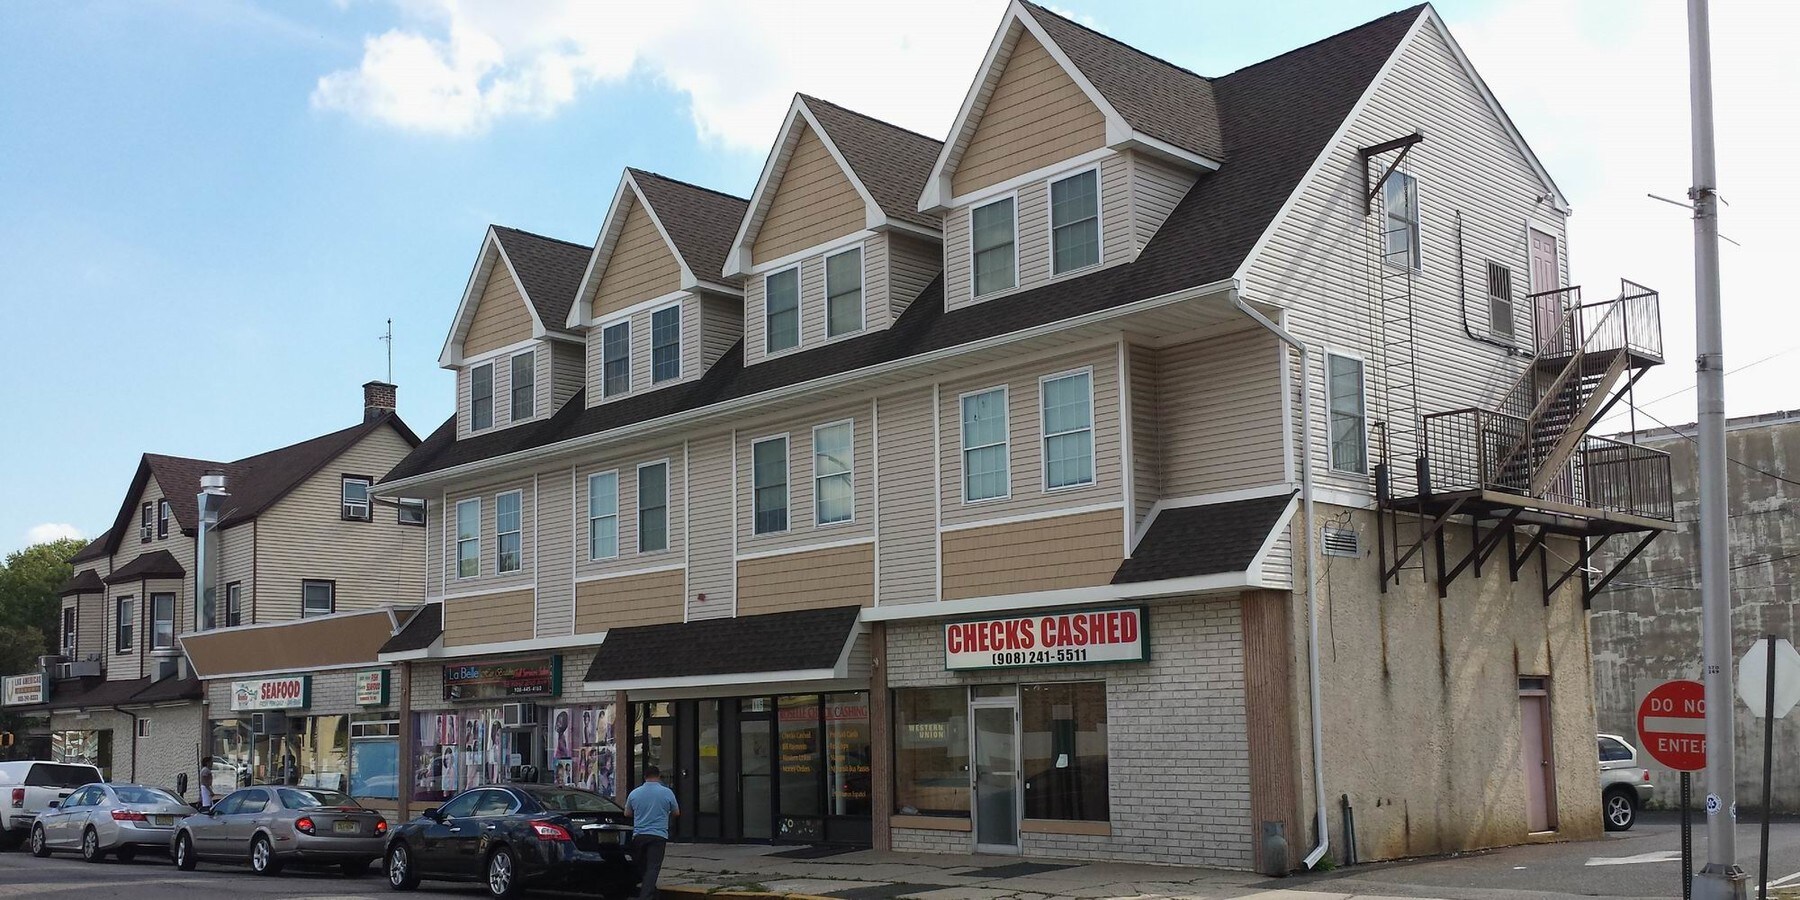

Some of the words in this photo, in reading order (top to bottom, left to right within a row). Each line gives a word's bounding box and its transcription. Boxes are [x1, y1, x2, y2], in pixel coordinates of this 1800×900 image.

[947, 618, 1035, 654] CHECKS
[1040, 611, 1138, 648] CASHED
[992, 652, 1026, 665] (908)
[1029, 649, 1087, 664] 241-5511
[449, 668, 459, 680] La
[460, 667, 479, 679] Belle
[261, 680, 301, 700] SEAFOOD
[835, 705, 867, 717] CASHING
[1651, 698, 1673, 712] DO
[1684, 699, 1706, 714] NO
[919, 731, 944, 739] UNION
